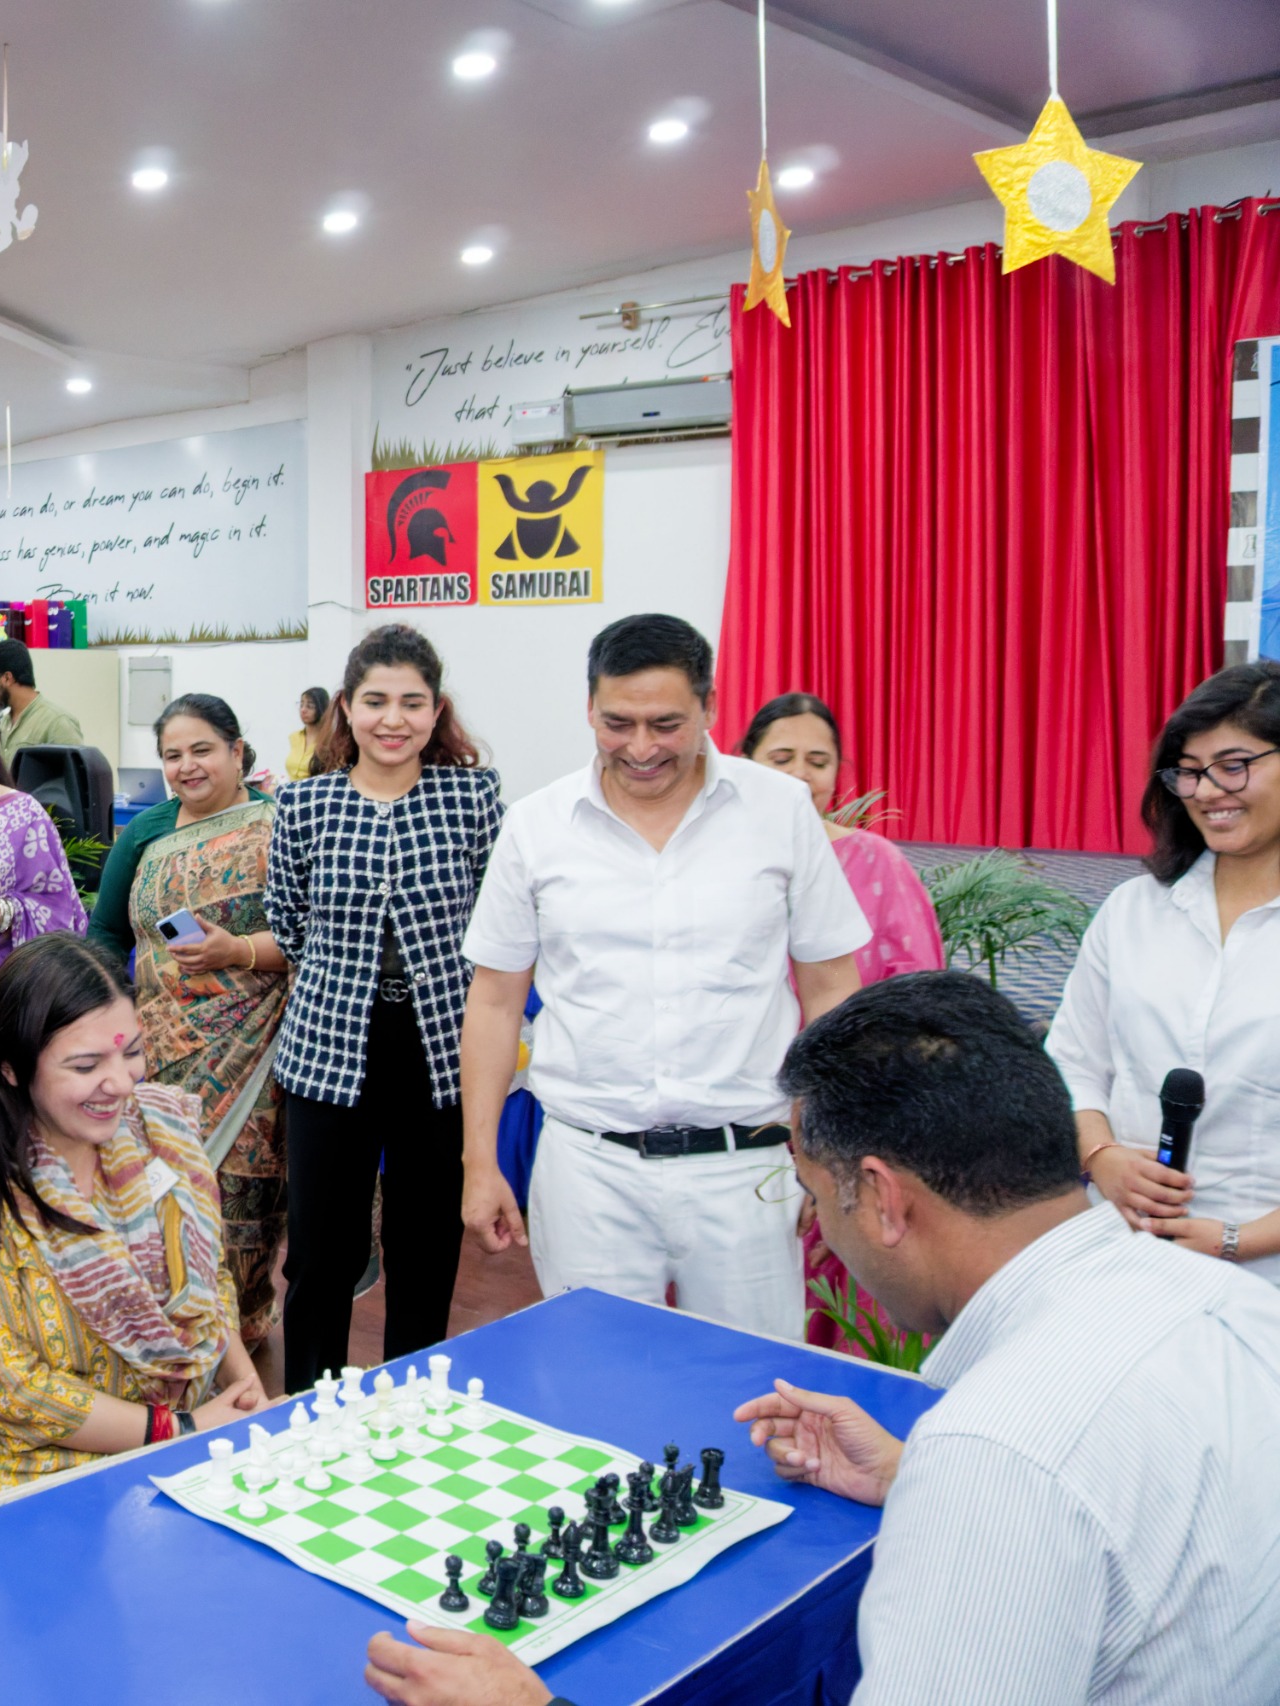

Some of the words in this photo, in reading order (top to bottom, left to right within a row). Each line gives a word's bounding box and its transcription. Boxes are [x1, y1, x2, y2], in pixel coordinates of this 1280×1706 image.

[481, 339, 544, 372] believe
[555, 346, 570, 362] in
[575, 316, 671, 369] yourself.
[454, 394, 500, 424] that
[12, 506, 34, 518] can
[39, 492, 57, 518] do,
[63, 499, 75, 511] or
[82, 486, 125, 508] dream
[128, 490, 153, 513] you
[160, 486, 186, 499] can
[192, 471, 214, 498] do,
[222, 467, 260, 506] begin
[267, 463, 284, 487] it.
[17, 536, 38, 561] has
[38, 542, 85, 573] genius,
[87, 535, 137, 565] power,
[143, 522, 175, 549] and
[179, 528, 220, 559] magic
[228, 526, 242, 542] in
[249, 514, 267, 538] it.
[105, 581, 120, 602] it
[126, 583, 155, 603] now.
[368, 574, 470, 604] SPARTANS
[490, 569, 591, 600] SAMURAI
